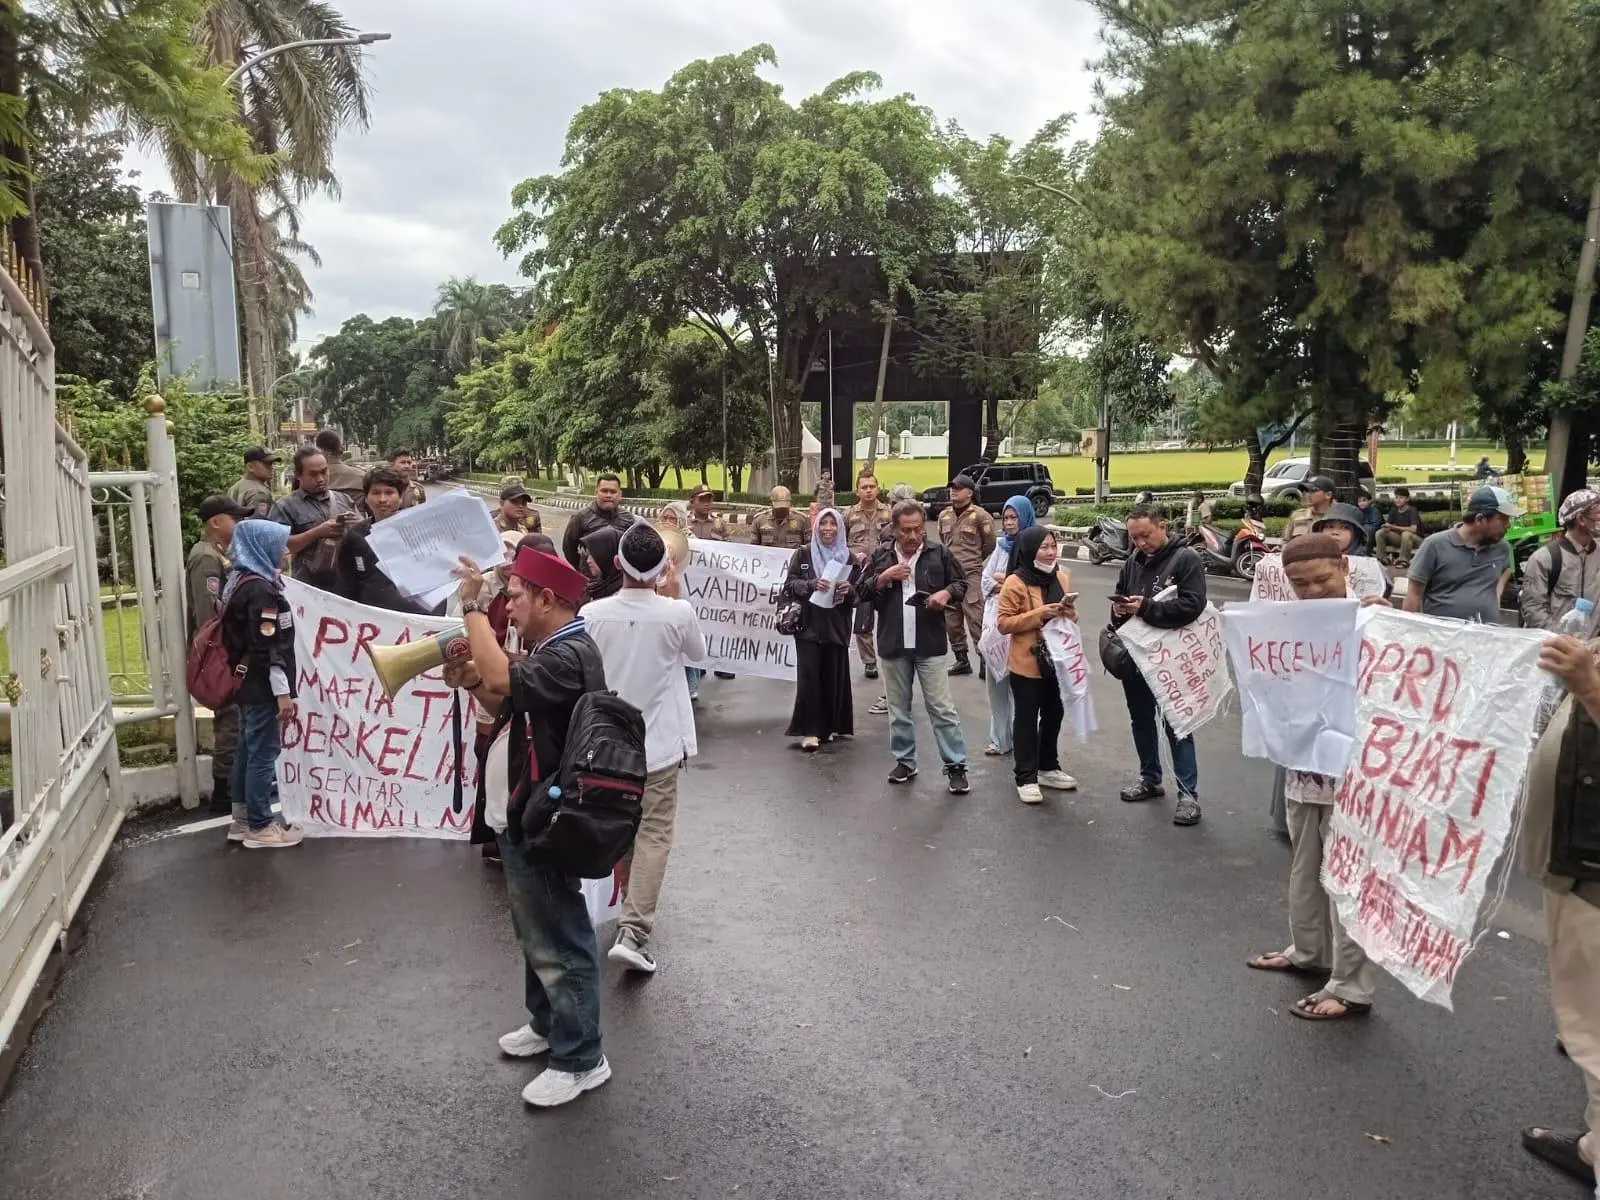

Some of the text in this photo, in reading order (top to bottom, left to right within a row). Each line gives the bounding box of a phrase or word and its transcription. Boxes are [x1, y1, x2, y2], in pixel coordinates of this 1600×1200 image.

[298, 666, 394, 717] MAFIA
[1157, 669, 1194, 717] GROUP
[284, 762, 404, 808] DI SEKITAR
